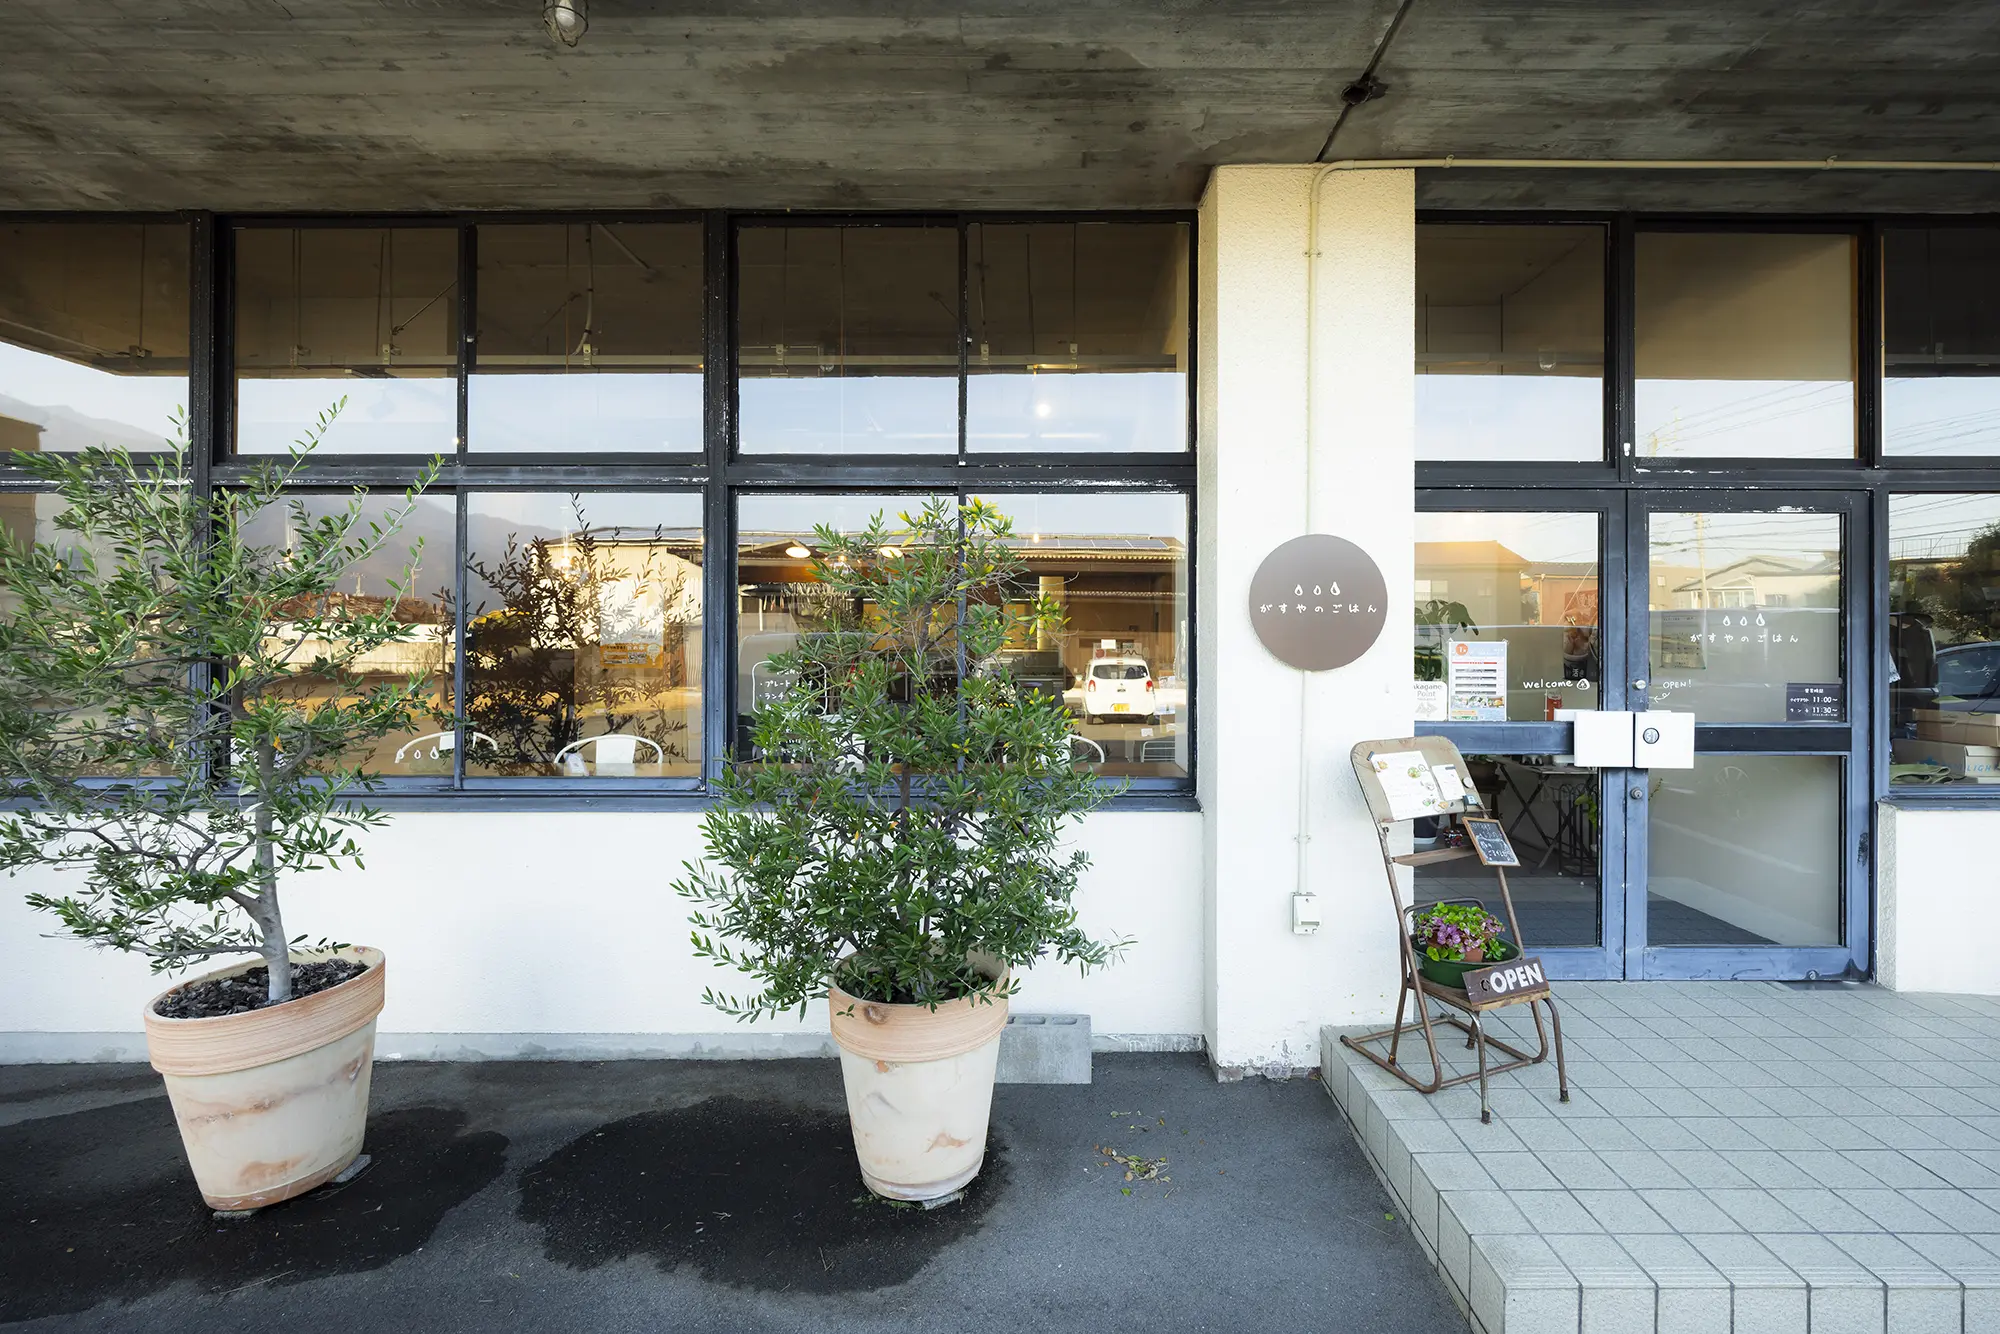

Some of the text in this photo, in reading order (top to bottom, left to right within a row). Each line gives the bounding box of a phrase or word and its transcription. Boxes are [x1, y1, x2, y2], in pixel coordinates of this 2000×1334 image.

[1259, 602, 1377, 614] がすやのごはん
[1690, 632, 1799, 643] がすやのごはん
[1489, 963, 1544, 993] OPEN
